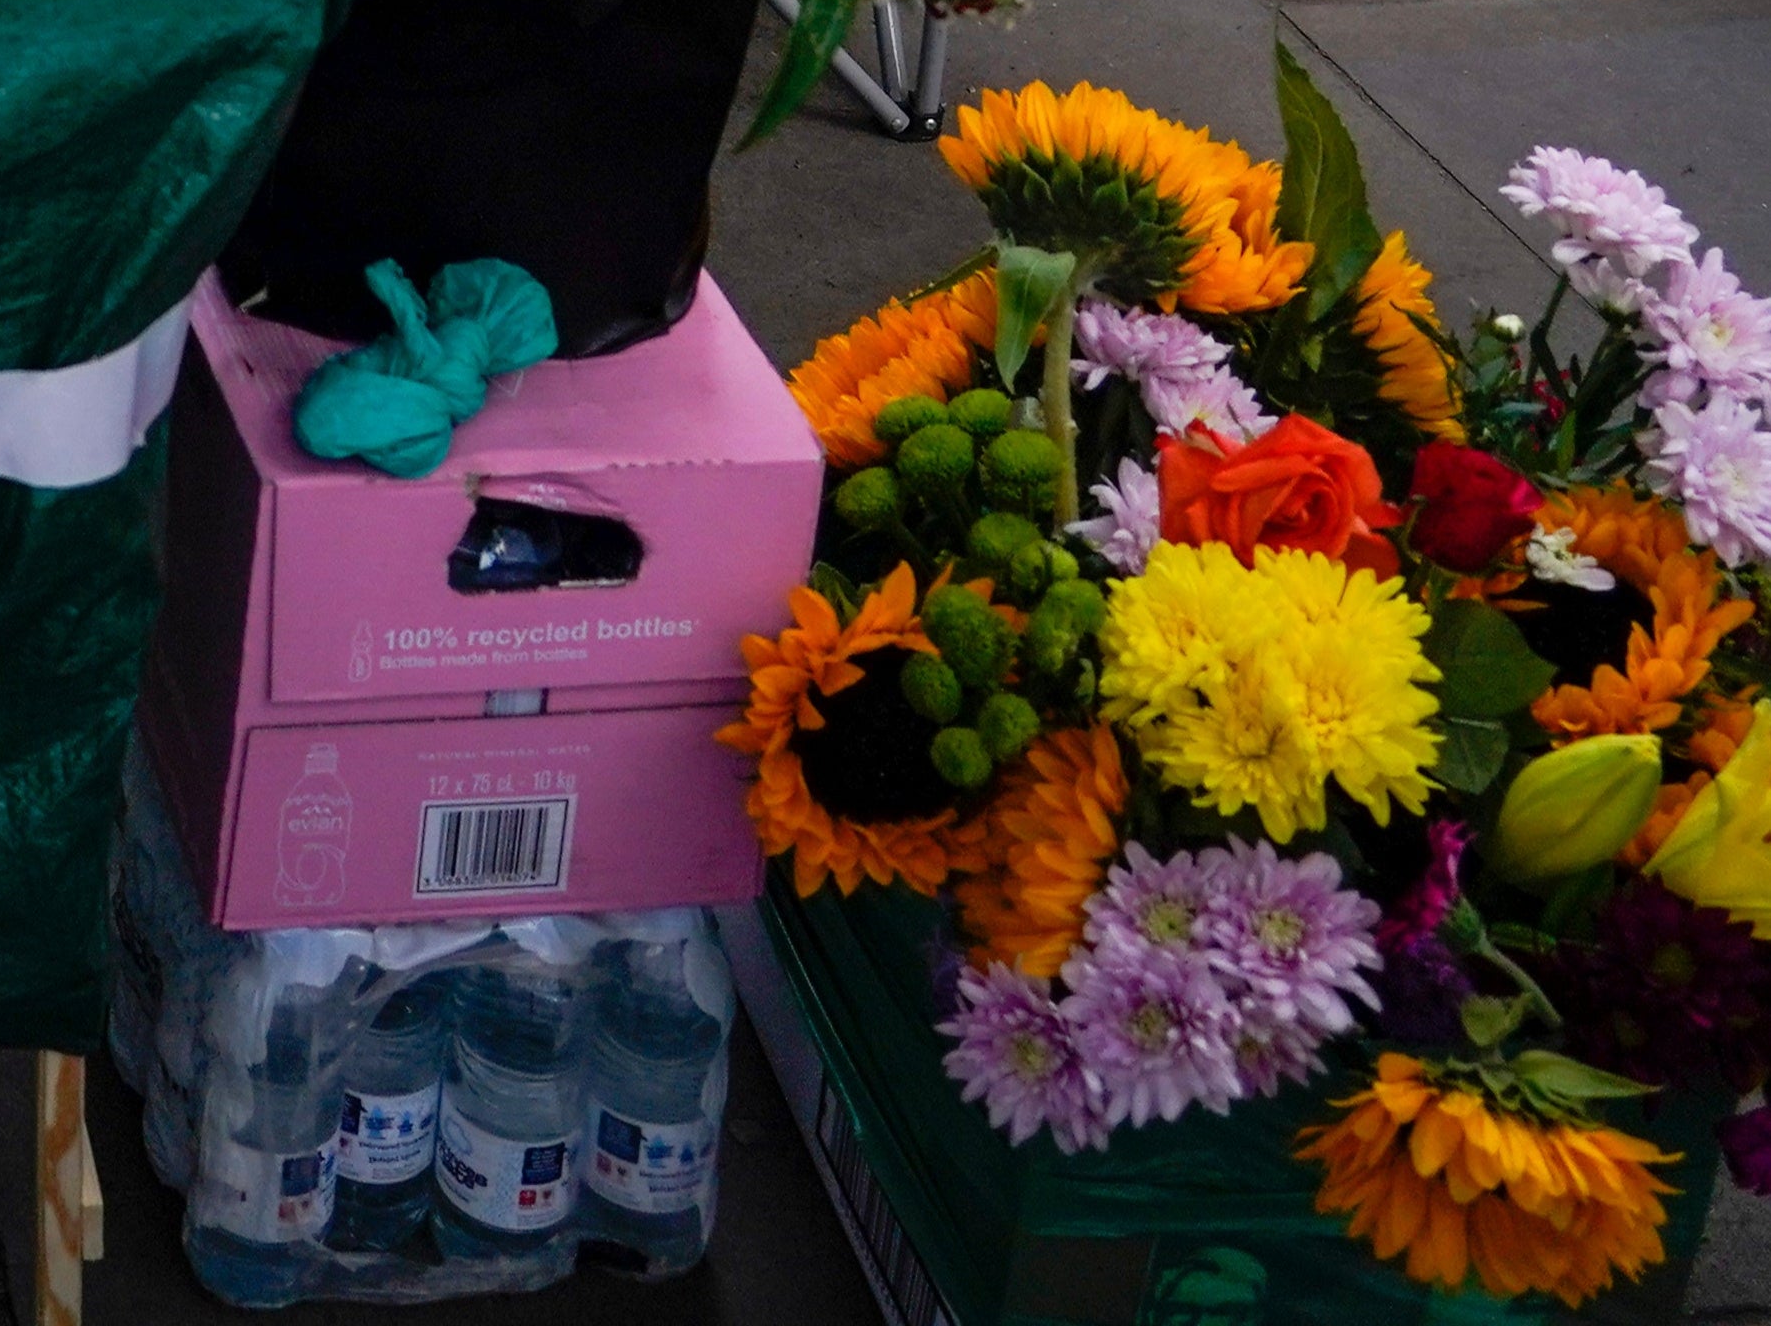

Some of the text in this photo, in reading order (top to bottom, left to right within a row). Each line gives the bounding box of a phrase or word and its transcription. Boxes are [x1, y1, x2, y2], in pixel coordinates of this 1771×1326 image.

[384, 627, 458, 650] 100%
[467, 620, 588, 649] recycled
[380, 648, 589, 670] Bottles made from bottles
[428, 775, 450, 796] 12
[454, 780, 463, 795] x
[471, 772, 492, 793] 75
[533, 770, 552, 791] 10
[556, 770, 577, 793] kg
[287, 816, 343, 833] evian
